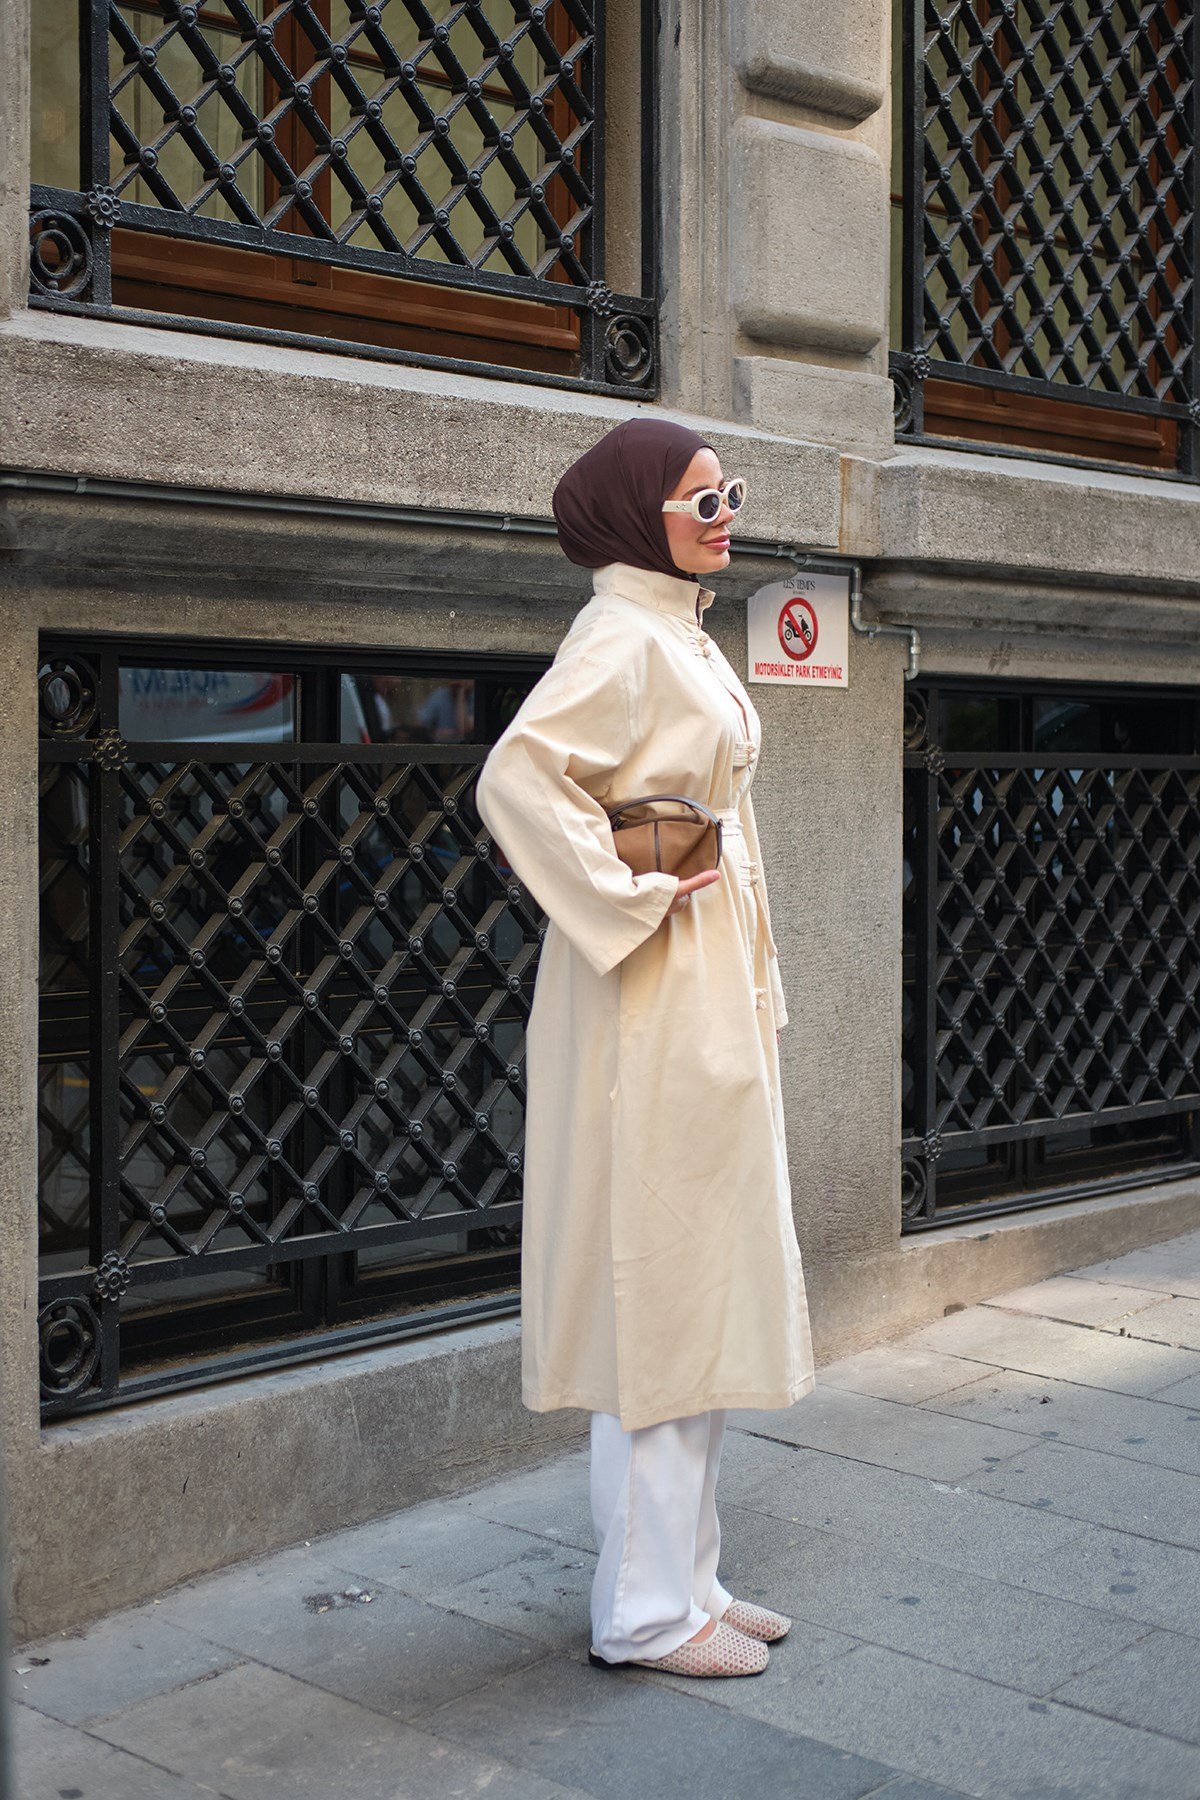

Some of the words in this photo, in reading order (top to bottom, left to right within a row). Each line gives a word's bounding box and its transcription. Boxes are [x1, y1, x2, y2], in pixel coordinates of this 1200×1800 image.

[755, 661, 794, 677] MOTORSİKLET
[796, 664, 811, 678] PARK
[812, 664, 842, 680] ETMEYİNİZ
